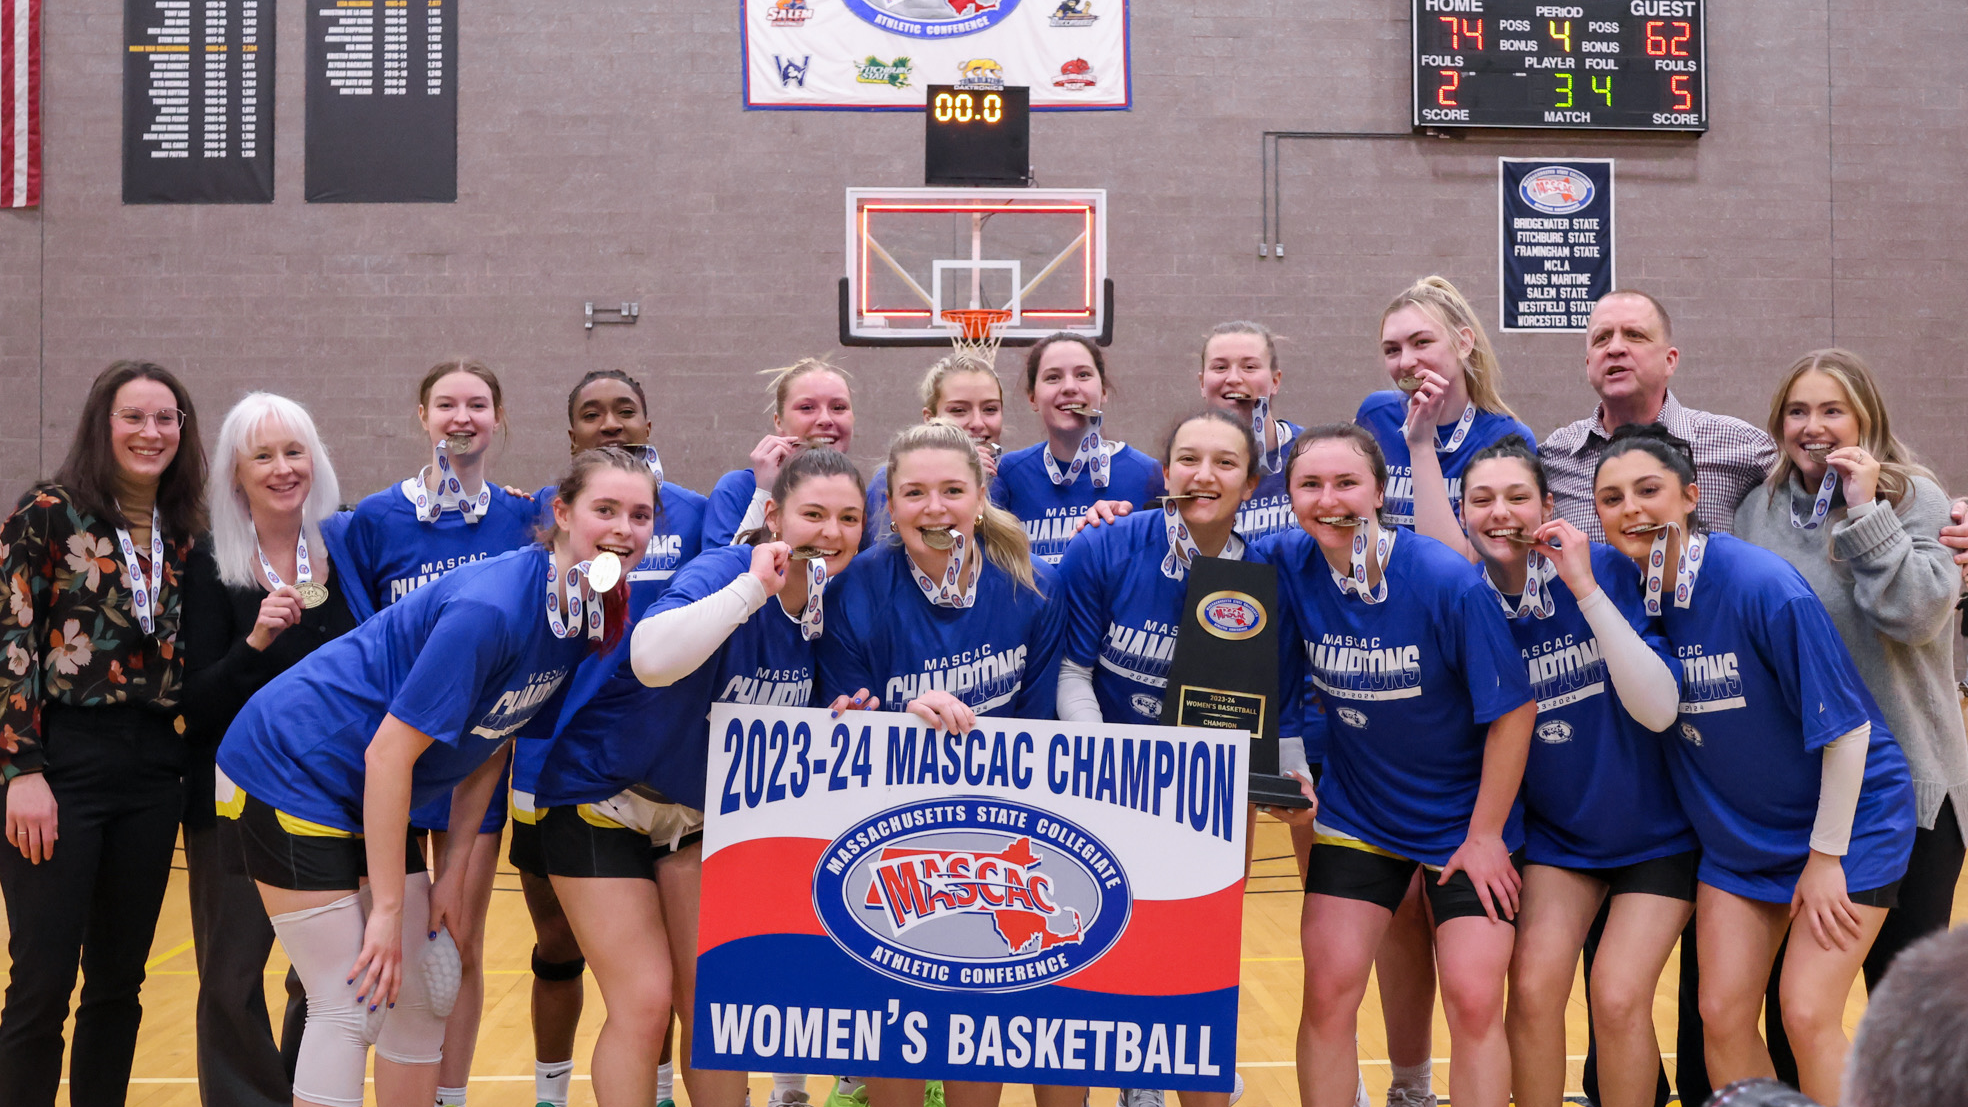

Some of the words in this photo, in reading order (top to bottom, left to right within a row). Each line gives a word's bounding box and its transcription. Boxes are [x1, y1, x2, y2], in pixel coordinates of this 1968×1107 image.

[1426, 0, 1483, 12] HOME
[1630, 1, 1696, 17] GUEST
[1536, 7, 1583, 18] PERIOD
[874, 13, 922, 34] ATHLETIC
[926, 15, 990, 35] CONFERENCE
[1500, 20, 1530, 31] POSS
[1589, 22, 1619, 33] POSS
[1439, 17, 1483, 50] 74
[1549, 20, 1570, 52] 4
[1646, 21, 1690, 55] 62
[1500, 40, 1538, 51] BONUS
[1582, 42, 1619, 53] BONUS
[1421, 55, 1463, 67] FOULS
[1525, 57, 1575, 69] PLAYER
[1585, 58, 1619, 70] FOUL
[1655, 60, 1697, 72] FOULS
[1438, 70, 1459, 105] 2
[1554, 73, 1573, 107] 3
[1591, 75, 1612, 107] 4
[1671, 75, 1691, 110] 5
[934, 93, 1002, 122] 00.0
[1422, 109, 1469, 120] SCORE
[1544, 112, 1590, 123] MATCH
[1652, 113, 1699, 125] SCORE
[1514, 218, 1569, 229] BRIDGEWATER
[1573, 218, 1600, 229] STATE
[1517, 232, 1564, 243] FITCHBURG
[1568, 232, 1596, 243] STATE
[1514, 245, 1570, 257] FRAMINGHAM
[1574, 246, 1600, 257] STATE
[1544, 260, 1570, 271] MCLA
[1524, 273, 1548, 285] MASS
[1551, 274, 1591, 285] MARITIME
[1527, 287, 1556, 298] SALEM
[1560, 287, 1588, 298] STATE
[1518, 301, 1565, 312] WESTFIELD
[1517, 315, 1567, 326] WORCESTER
[1571, 315, 1590, 326] STA
[1386, 465, 1411, 476] MAS
[1240, 494, 1290, 511] ASCAC
[1046, 505, 1088, 517] MASC
[1144, 619, 1179, 636] MAS
[1521, 634, 1573, 659] ASCAC
[1678, 644, 1703, 658] CAC
[924, 644, 992, 671] MASCAC
[1210, 694, 1236, 704] 2023-24
[1186, 699, 1217, 710] WOMEN'S
[1217, 704, 1258, 715] BASKETBALL
[1203, 719, 1238, 729] CHAMPION
[719, 717, 873, 816] 2023-24
[885, 726, 1034, 790] MASCAC
[1046, 732, 1237, 843] CHAMPION
[825, 805, 967, 876] MASSACHUSETTS
[976, 805, 1028, 829] STATE
[1035, 817, 1123, 891] COLLEGIATE
[873, 851, 1060, 929] MASCAC
[870, 945, 949, 982] ATHLETIC
[960, 952, 1070, 985] CONFERENCE
[947, 1013, 1221, 1077] BASKETBALL
